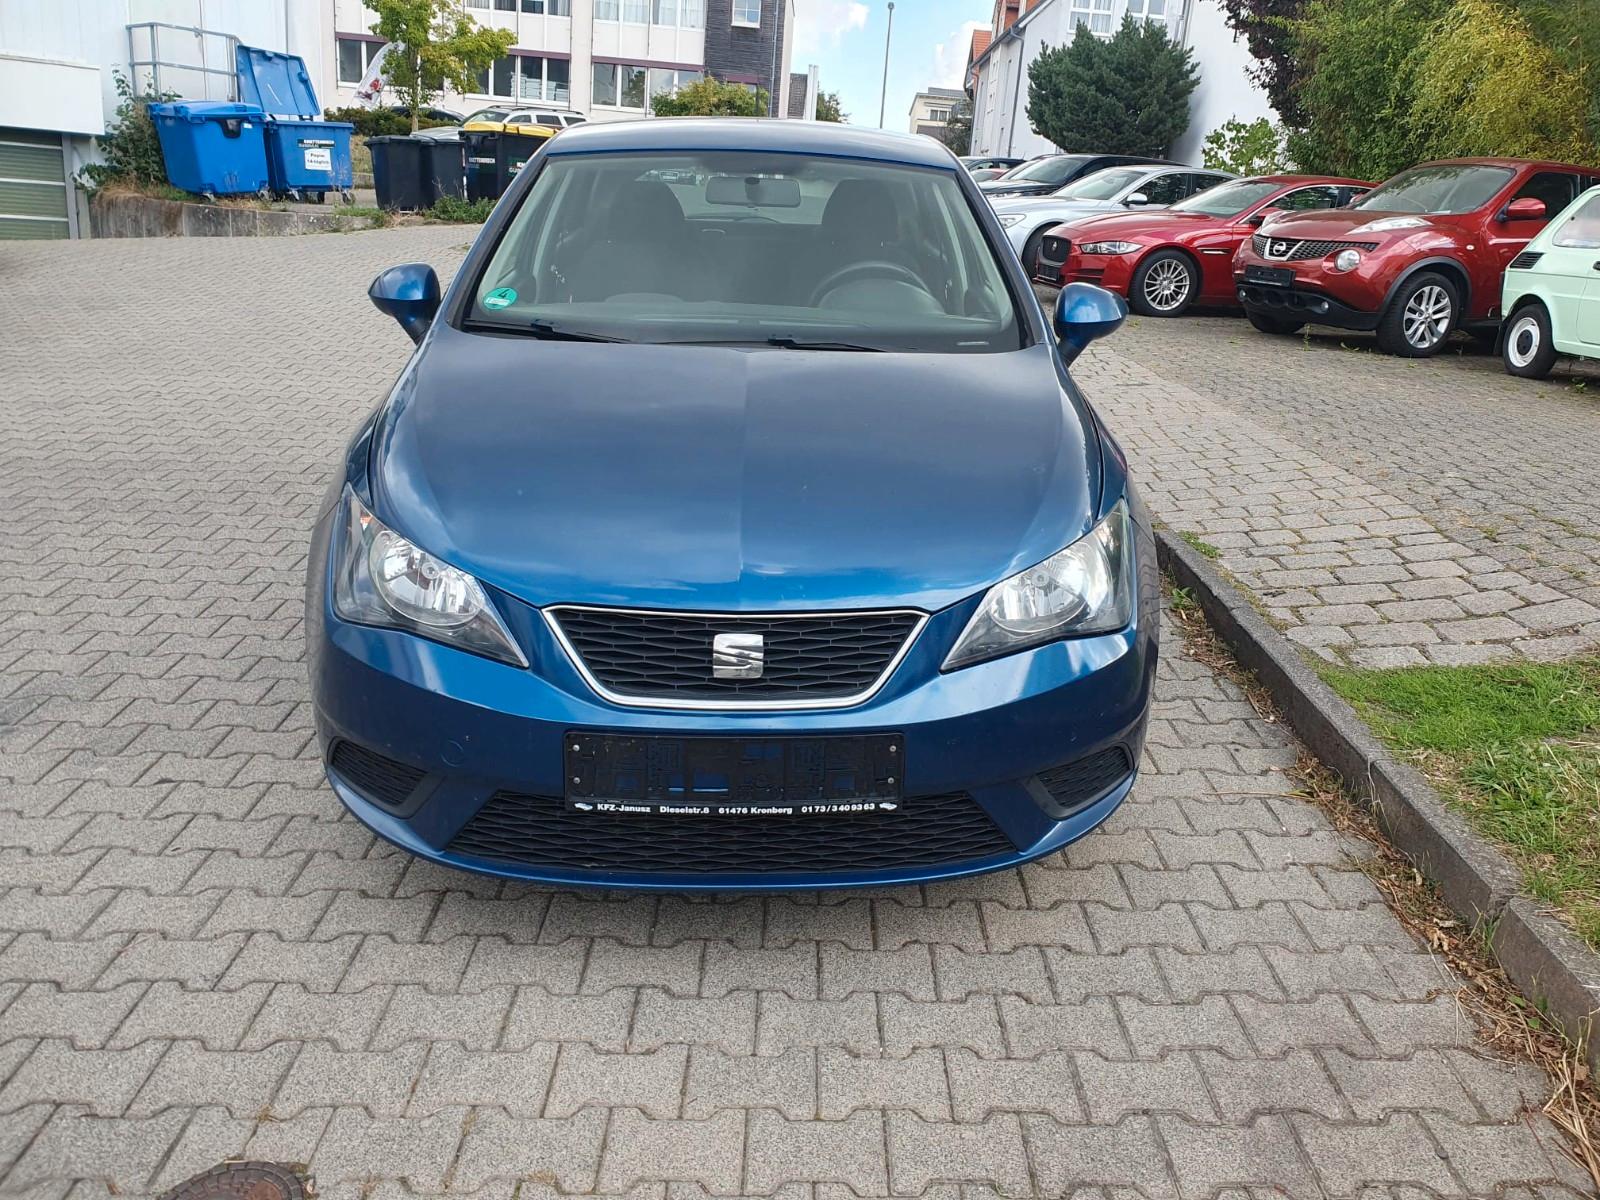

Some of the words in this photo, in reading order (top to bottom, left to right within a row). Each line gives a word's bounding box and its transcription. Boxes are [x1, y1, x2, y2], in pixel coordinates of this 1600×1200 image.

[497, 288, 511, 299] 4
[597, 803, 652, 813] KFZ-Janusz
[750, 806, 793, 815] Kronberg
